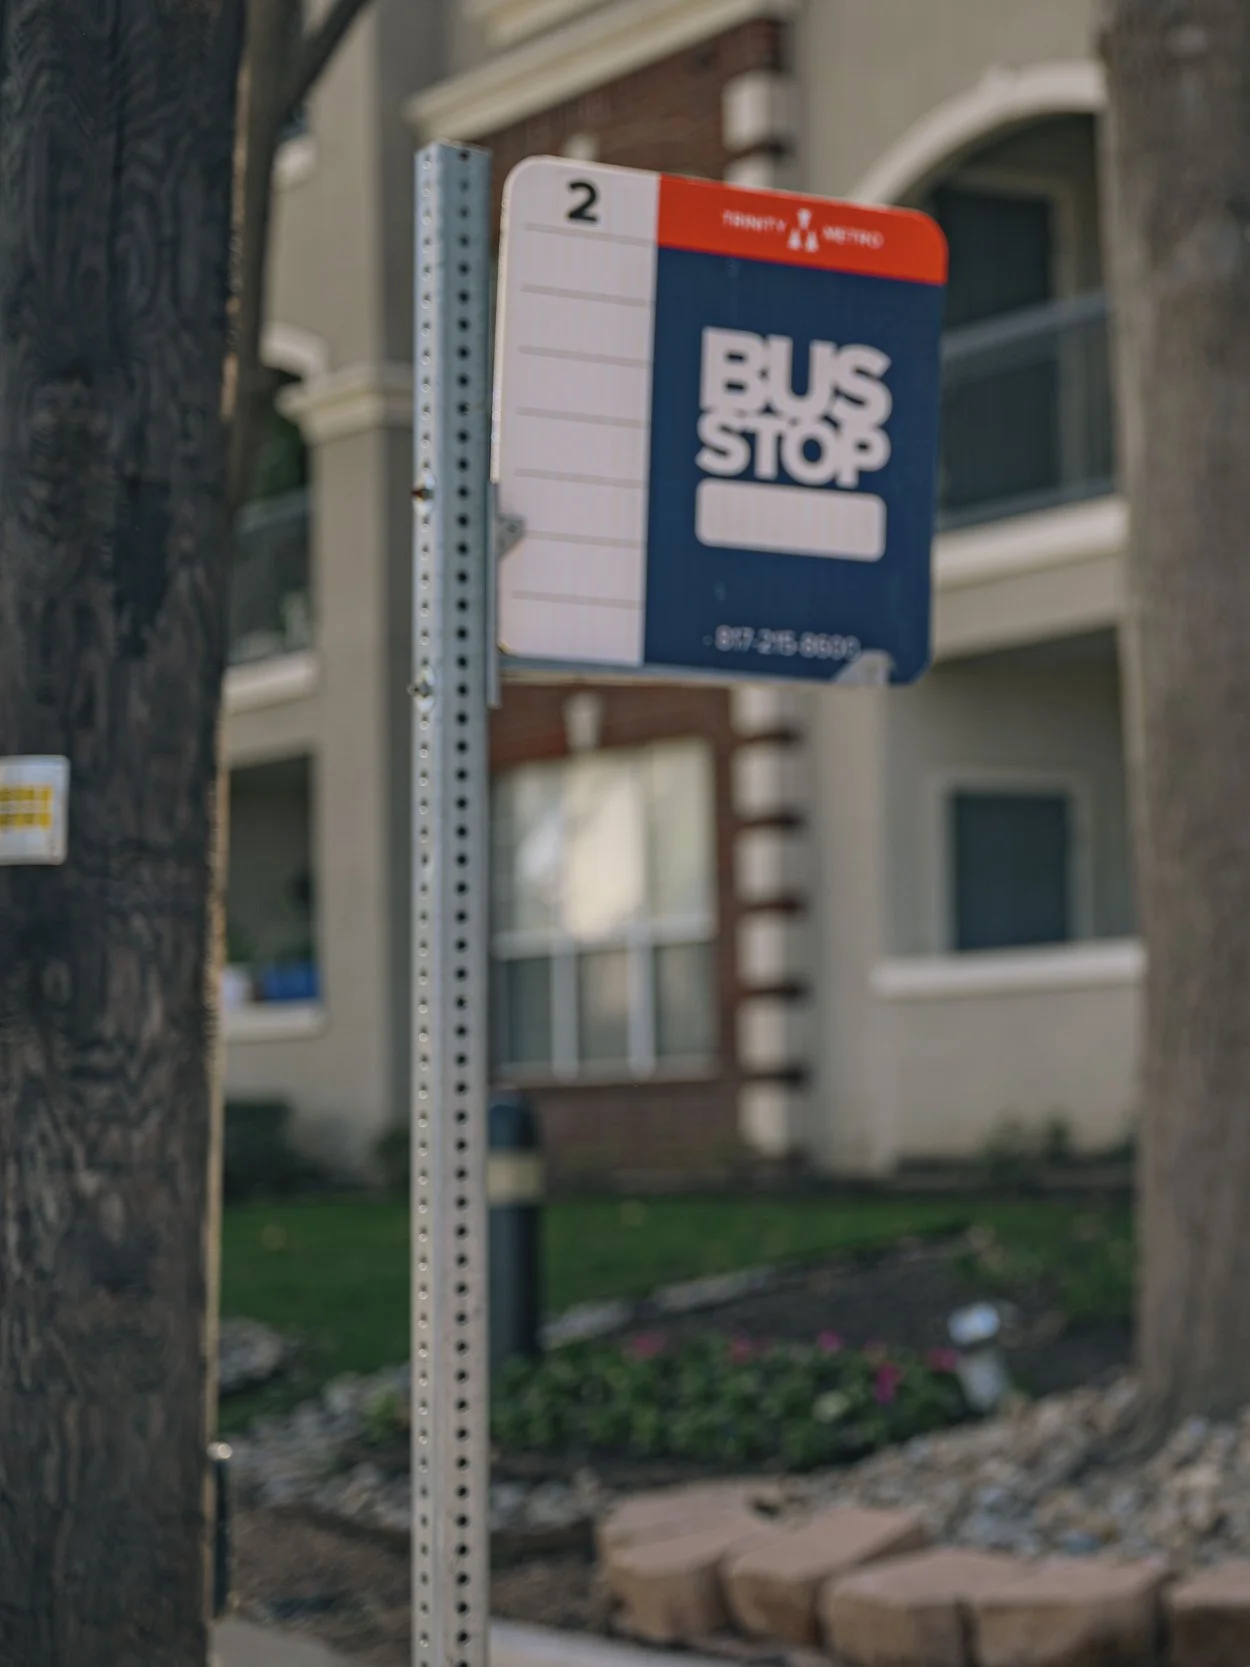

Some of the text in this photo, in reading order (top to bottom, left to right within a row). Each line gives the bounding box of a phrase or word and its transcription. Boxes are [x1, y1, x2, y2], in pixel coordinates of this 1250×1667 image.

[565, 179, 599, 223] 2
[701, 326, 893, 425] BUS
[696, 408, 892, 488] STOP
